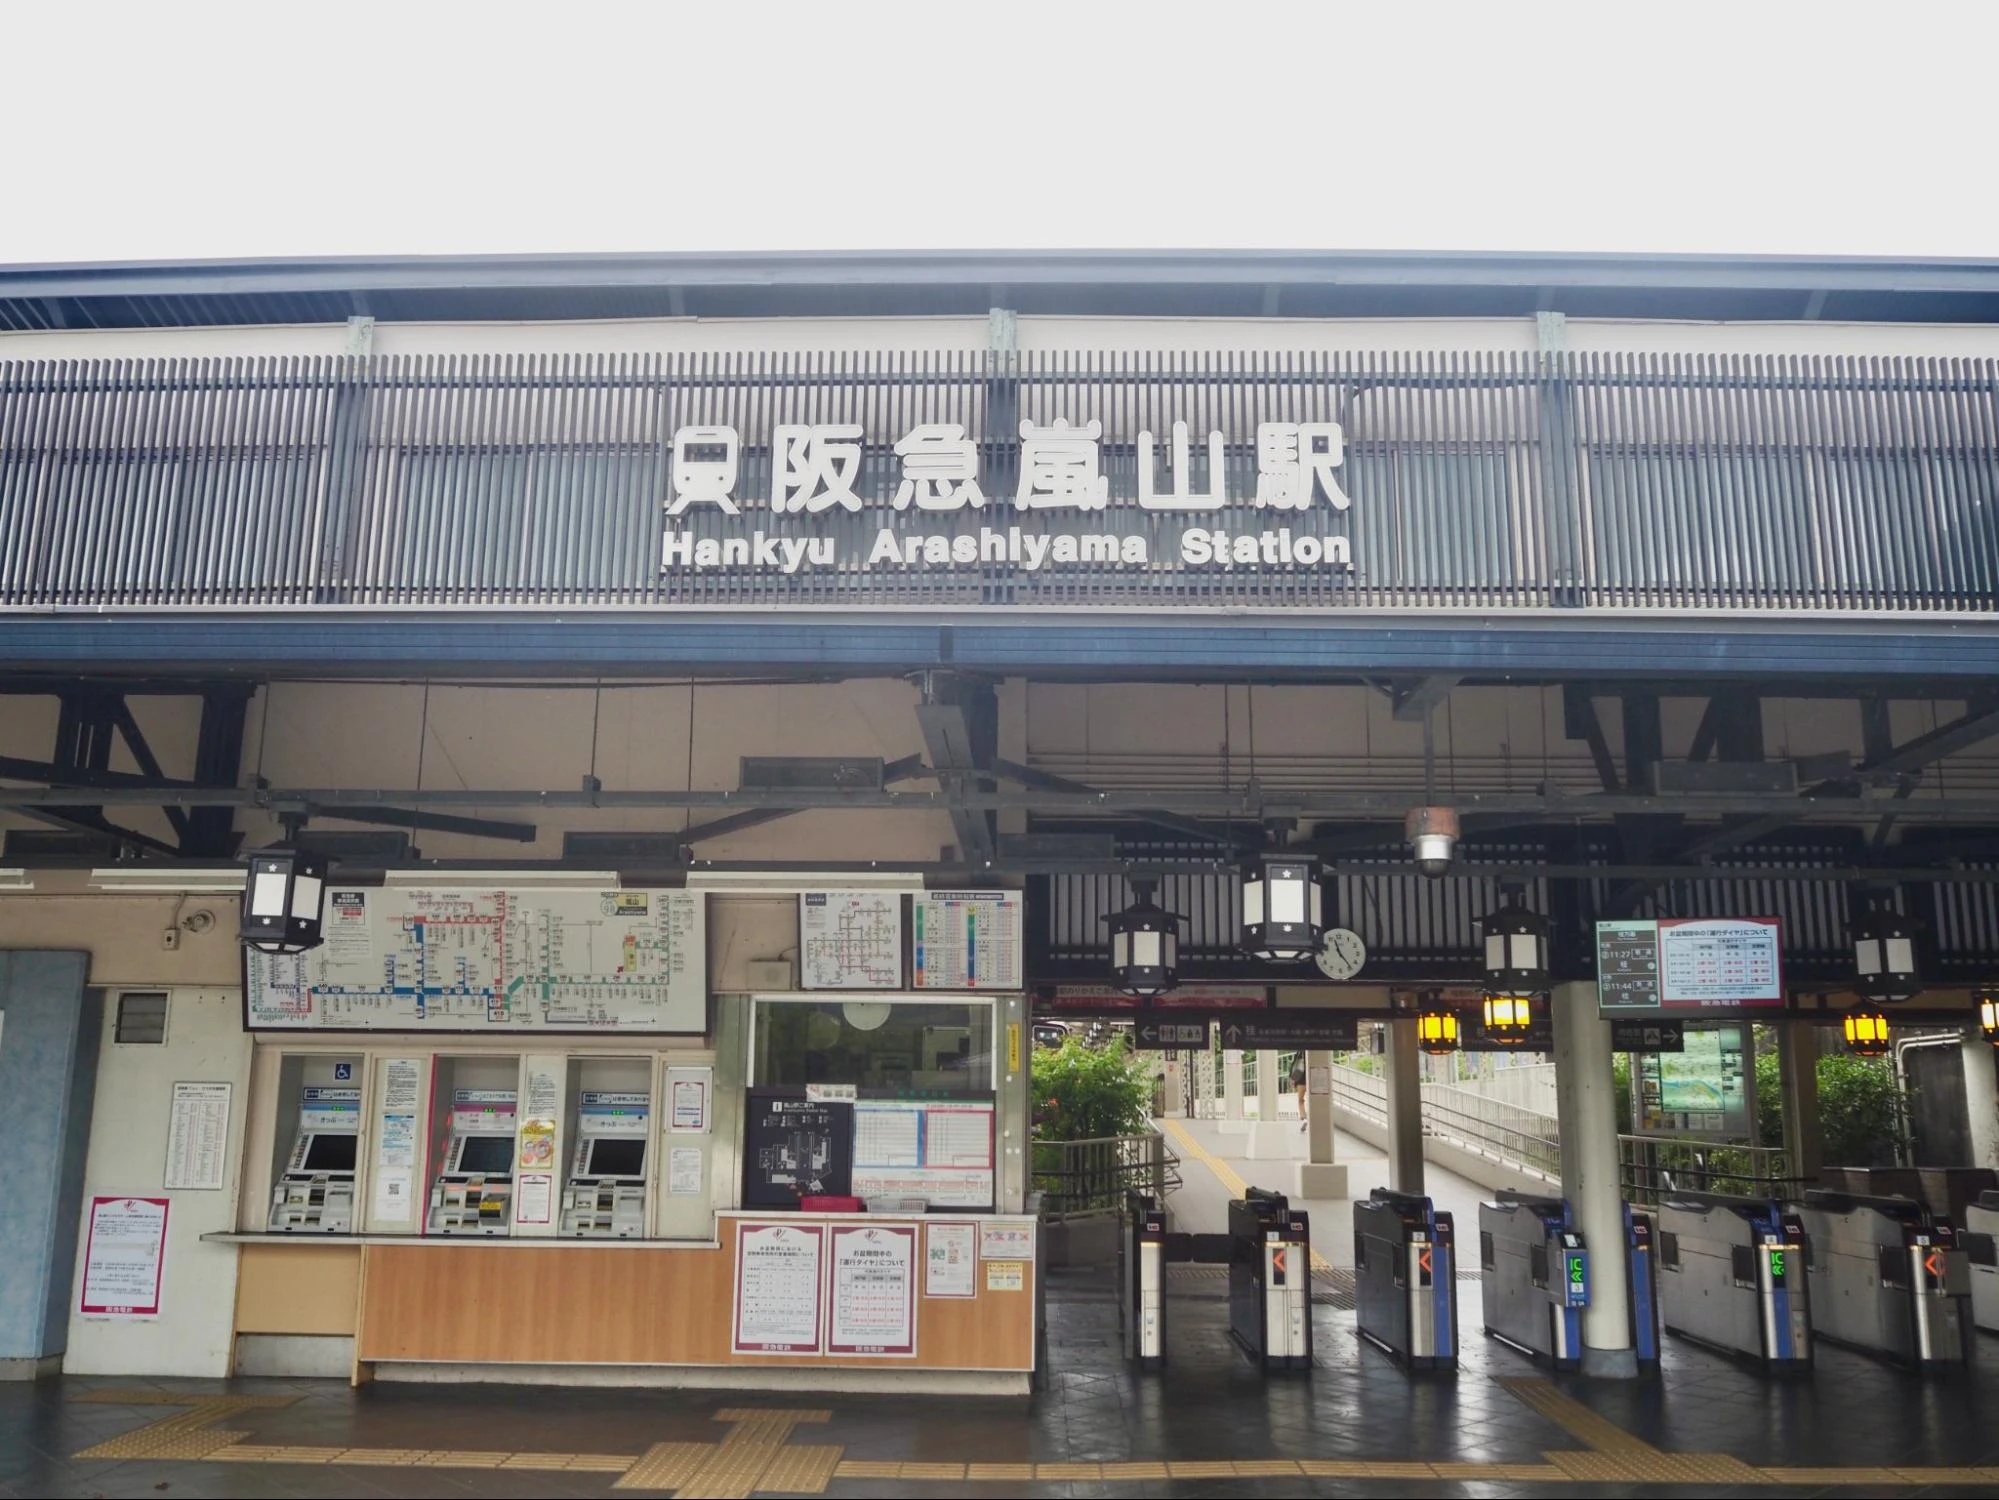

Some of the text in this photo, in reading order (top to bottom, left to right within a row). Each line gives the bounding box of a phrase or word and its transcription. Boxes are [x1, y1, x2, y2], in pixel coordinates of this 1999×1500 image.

[772, 417, 1351, 514] 阪急嵐山駅
[662, 525, 1351, 573] Hankyu Arashiyama Station
